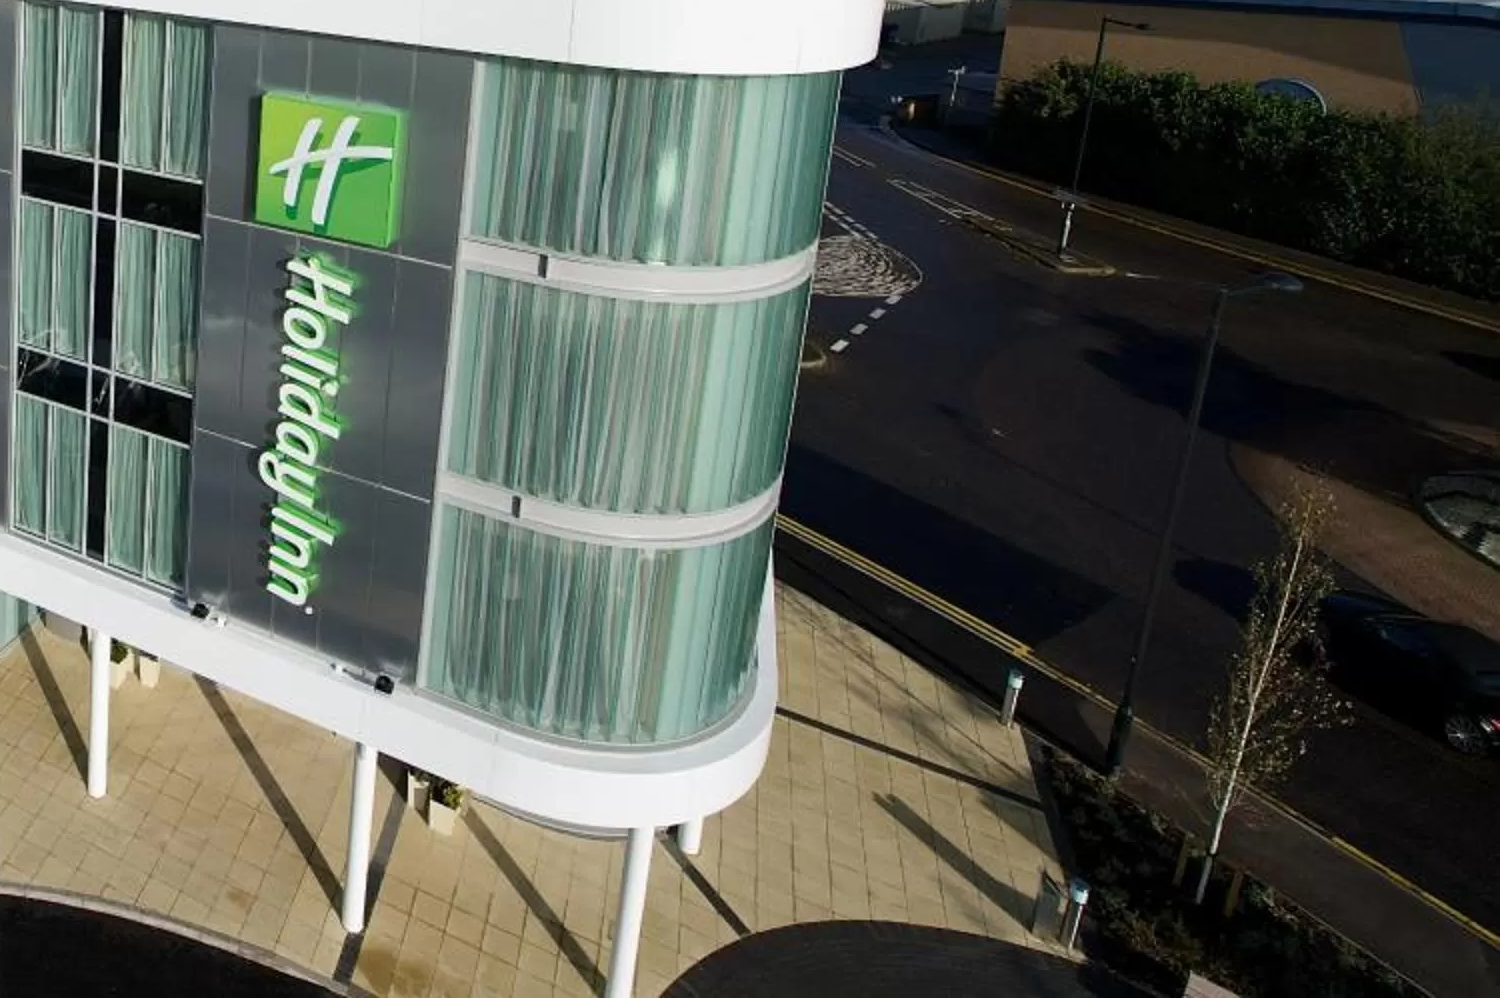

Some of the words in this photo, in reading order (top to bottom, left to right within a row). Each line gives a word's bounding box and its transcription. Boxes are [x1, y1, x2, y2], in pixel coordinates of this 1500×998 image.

[269, 116, 392, 224] H
[258, 256, 353, 509] Holiday
[266, 507, 335, 605] Inn
